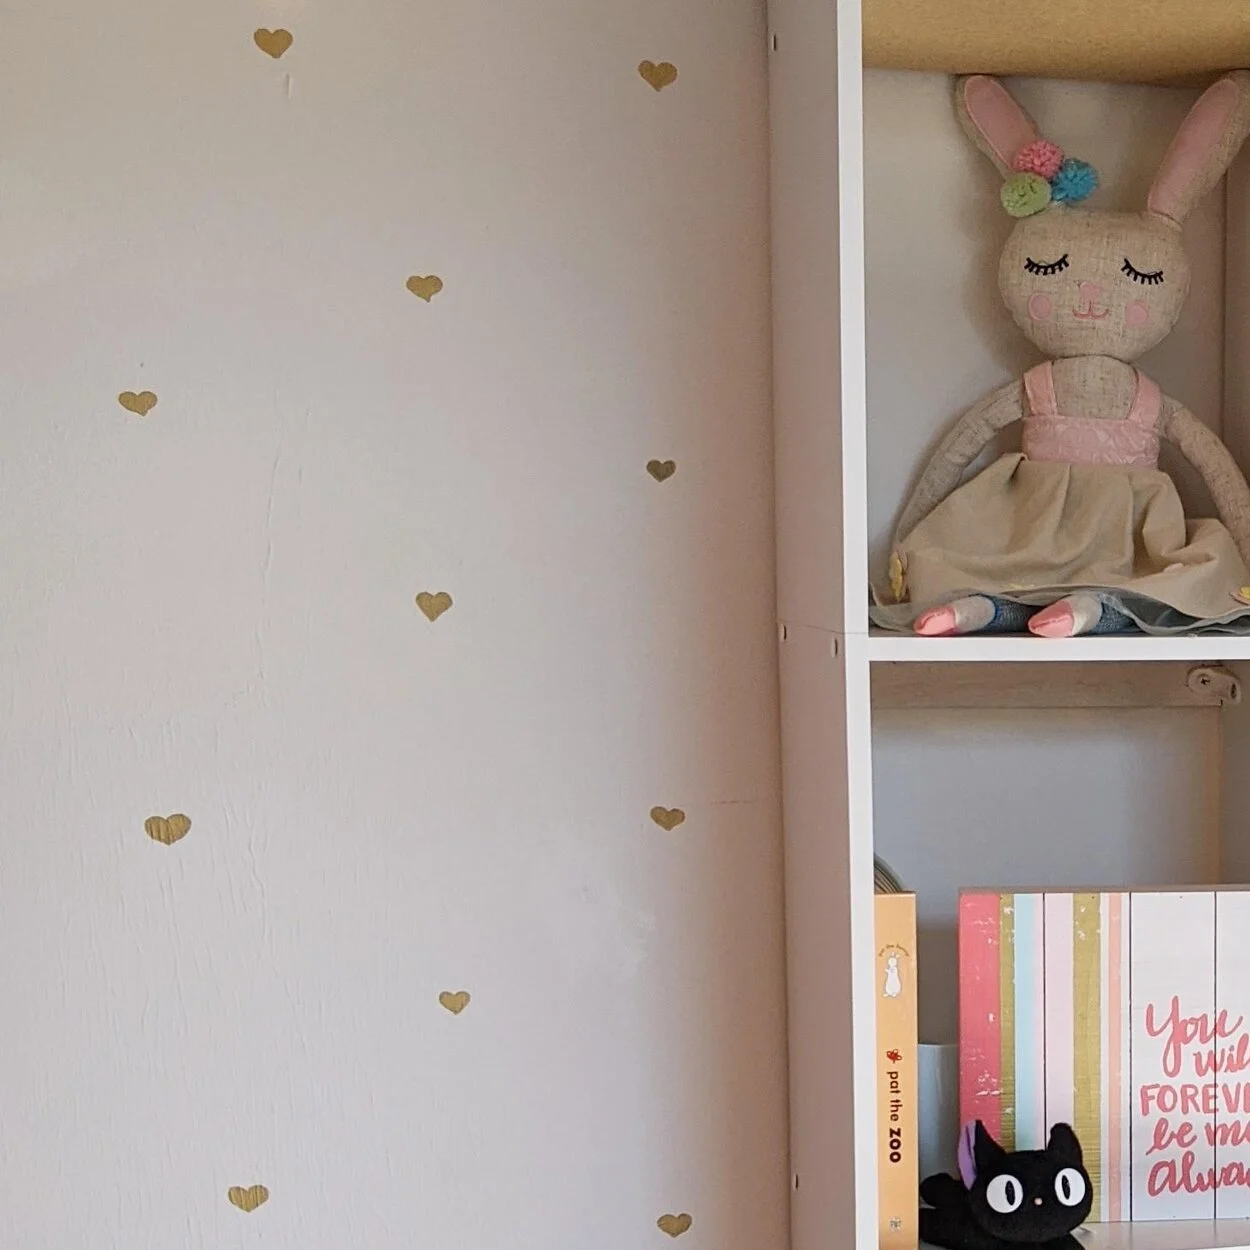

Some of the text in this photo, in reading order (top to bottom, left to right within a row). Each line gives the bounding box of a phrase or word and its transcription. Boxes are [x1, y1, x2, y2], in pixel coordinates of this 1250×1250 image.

[1145, 995, 1244, 1078] You
[886, 1070, 903, 1164] pat the zoo
[1145, 1117, 1197, 1156] be
